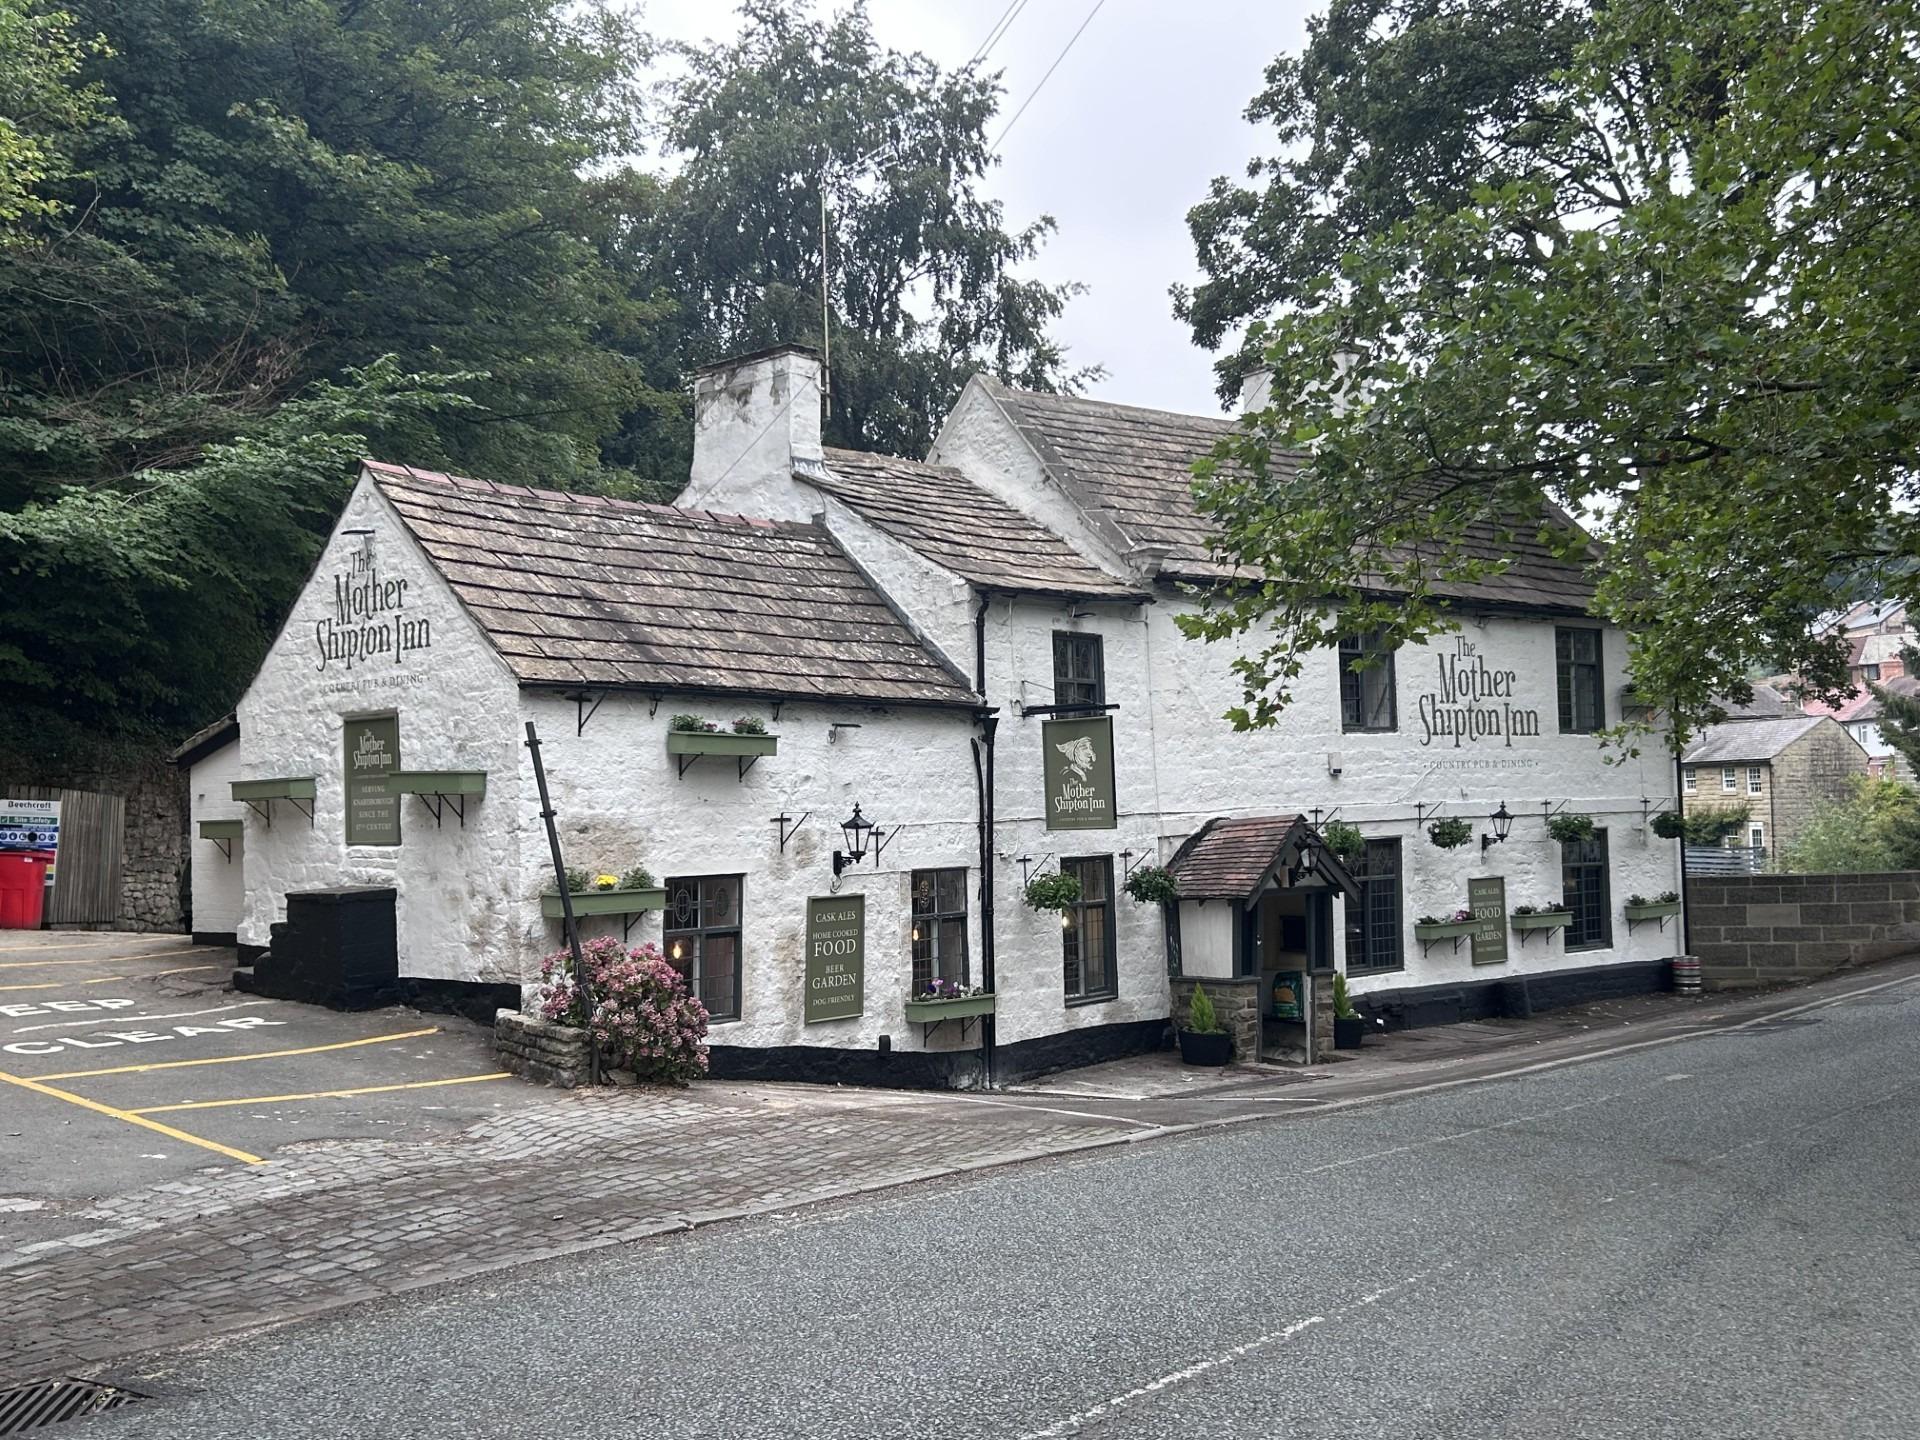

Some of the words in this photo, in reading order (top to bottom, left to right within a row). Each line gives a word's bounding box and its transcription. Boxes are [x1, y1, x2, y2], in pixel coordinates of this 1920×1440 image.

[351, 550, 374, 579] The
[334, 568, 408, 626] Mother
[316, 617, 392, 672] Shipton
[395, 614, 431, 664] Inn
[1455, 635, 1476, 661] The
[1437, 653, 1516, 704] Mother
[1419, 693, 1502, 748] Shipton
[1503, 702, 1540, 747] Inn
[359, 735, 385, 754] Mother
[353, 750, 380, 769] Shipton
[380, 751, 392, 768] Inn
[1429, 759, 1471, 770] COUNTRY
[1474, 759, 1489, 769] PUB
[1492, 760, 1498, 769] &
[1501, 759, 1533, 768] DINING
[1062, 783, 1095, 800] Mother
[8, 800, 51, 809] Beechcroft
[1054, 796, 1089, 813] Shipton
[1089, 797, 1105, 812] Inn
[14, 816, 28, 824] Site
[29, 816, 51, 825] Safety
[815, 912, 836, 923] CASK
[837, 910, 856, 921] ALES
[1474, 907, 1501, 919] FOOD
[812, 931, 832, 940] HOME
[832, 928, 859, 938] COOKED
[1475, 931, 1502, 942] GARDEN
[814, 938, 856, 957] FOOD
[825, 963, 844, 974] BEER
[812, 972, 857, 990] GARDEN
[812, 998, 827, 1006] DOG
[827, 994, 855, 1004] FRIENDLY
[3, 1016, 288, 1054] CLEAR
